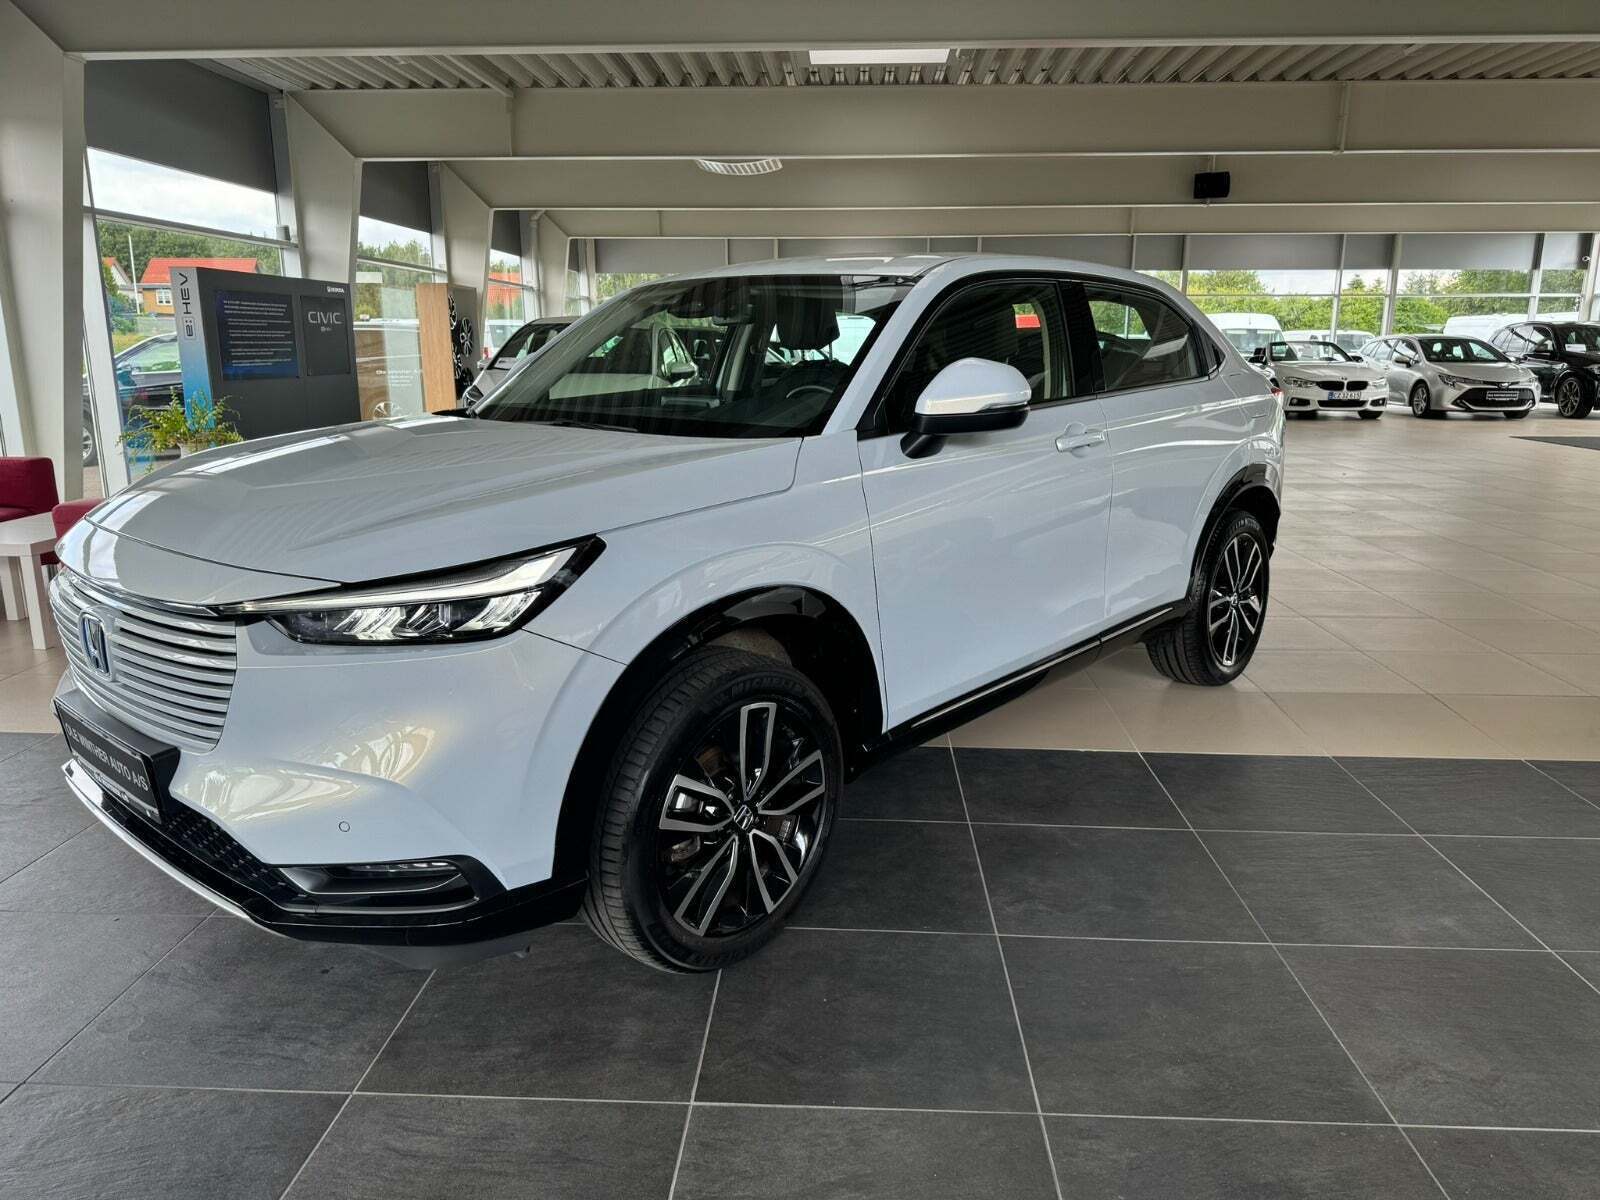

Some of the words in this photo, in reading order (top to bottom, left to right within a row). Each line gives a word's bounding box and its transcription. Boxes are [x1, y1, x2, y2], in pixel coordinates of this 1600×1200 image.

[308, 311, 343, 325] CIVIC
[109, 756, 131, 781] AUTO
[132, 771, 149, 791] A/S
